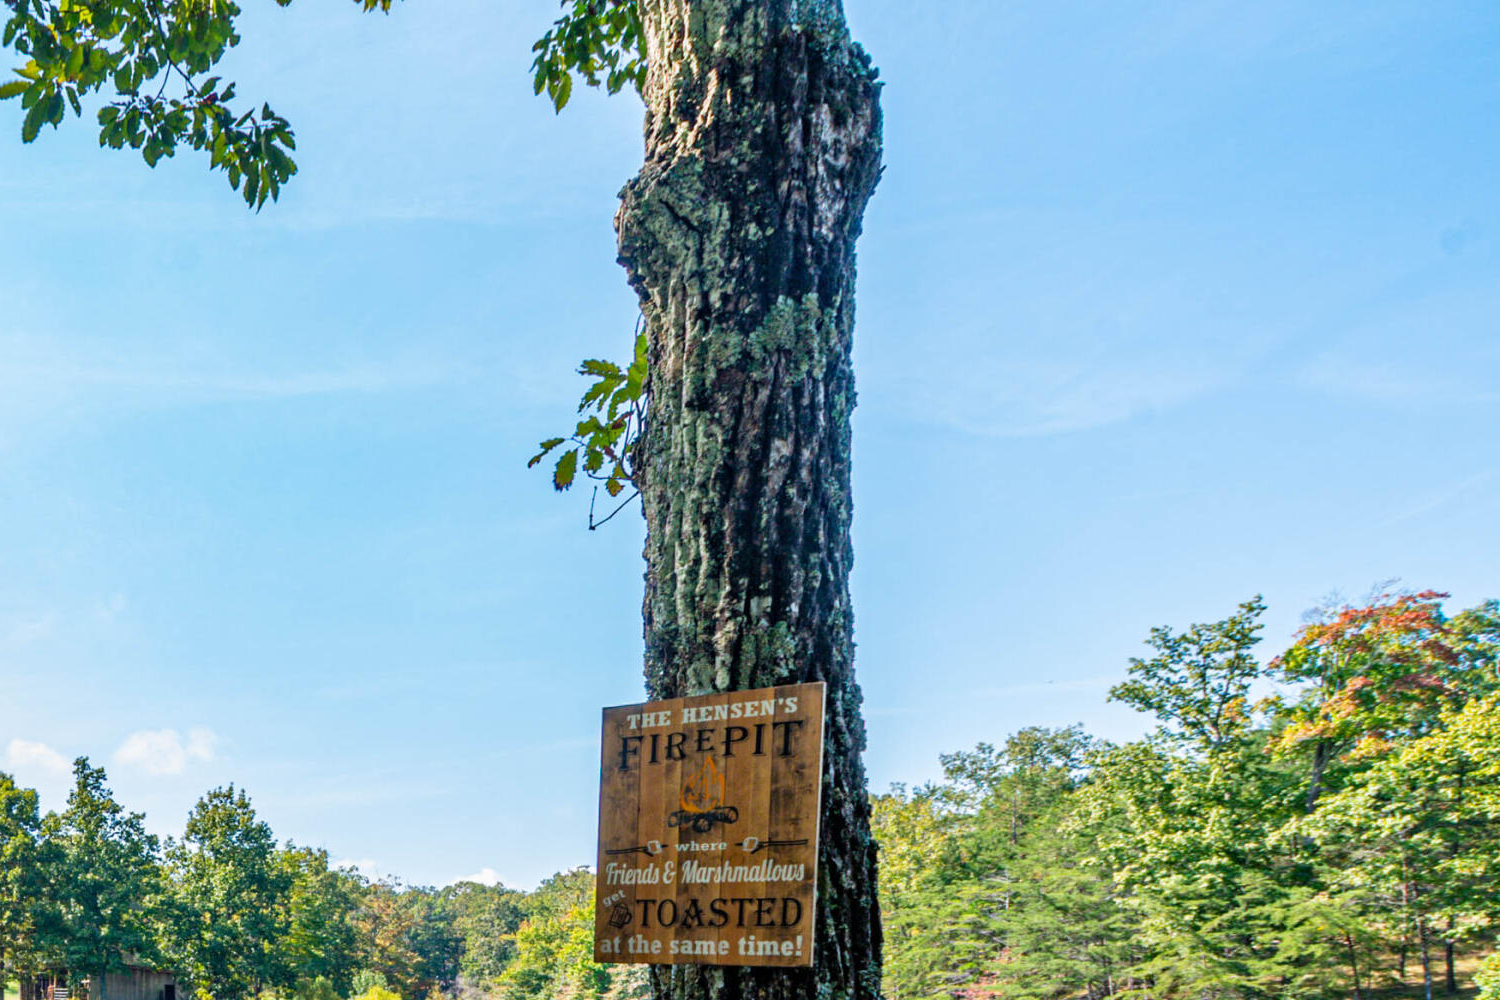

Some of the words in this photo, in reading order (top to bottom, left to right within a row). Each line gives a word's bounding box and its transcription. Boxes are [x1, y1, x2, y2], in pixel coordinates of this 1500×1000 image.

[627, 710, 672, 730] THE
[681, 697, 799, 724] HENSEN'S
[618, 720, 804, 771] FIREPIT
[675, 841, 727, 852] where
[605, 861, 660, 885] Friends
[662, 861, 676, 883] &
[681, 859, 805, 884] Marshmallows
[602, 889, 627, 908] get
[636, 897, 803, 929] TOASTED
[600, 936, 621, 954] at
[628, 934, 663, 954] the
[669, 938, 730, 954] same
[738, 935, 803, 957] time!
